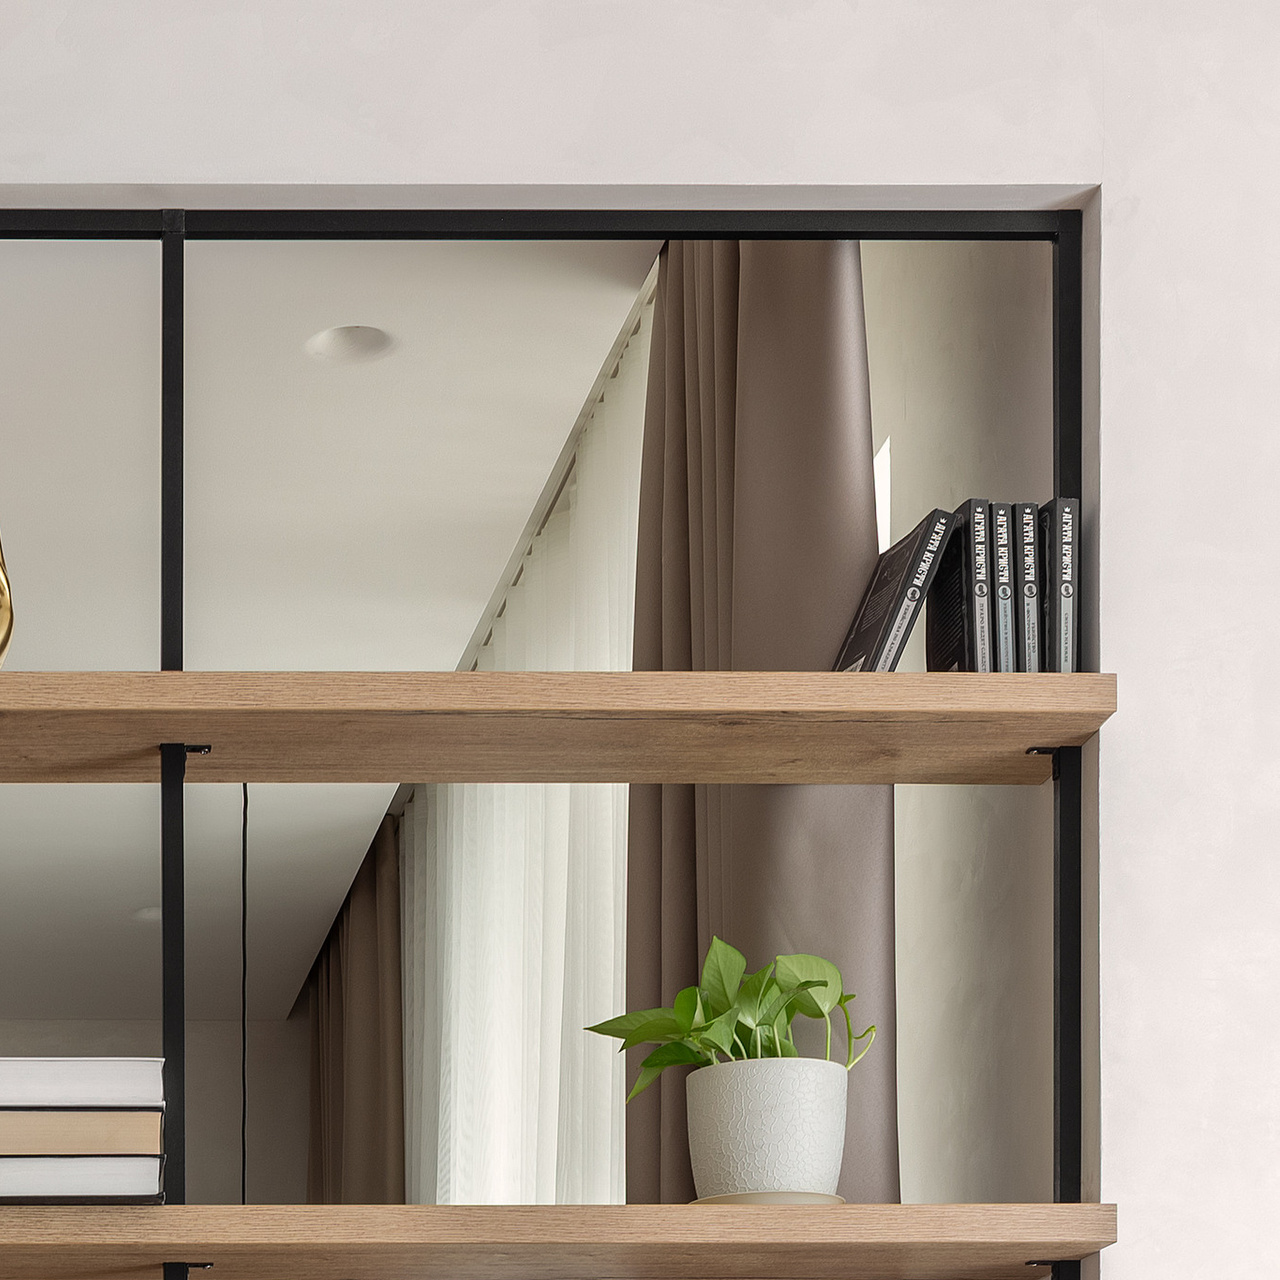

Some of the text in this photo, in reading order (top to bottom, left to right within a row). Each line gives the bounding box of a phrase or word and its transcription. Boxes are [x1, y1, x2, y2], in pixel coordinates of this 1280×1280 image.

[912, 522, 946, 587] АГАТА КРИСТИ
[974, 512, 986, 581] АГАТА КРИСТИ
[996, 515, 1010, 583] АГАТА КРИСТИ
[1023, 513, 1035, 581] АГАТА КРИСТИ
[1061, 512, 1073, 581] АГАТА КРИСТИ
